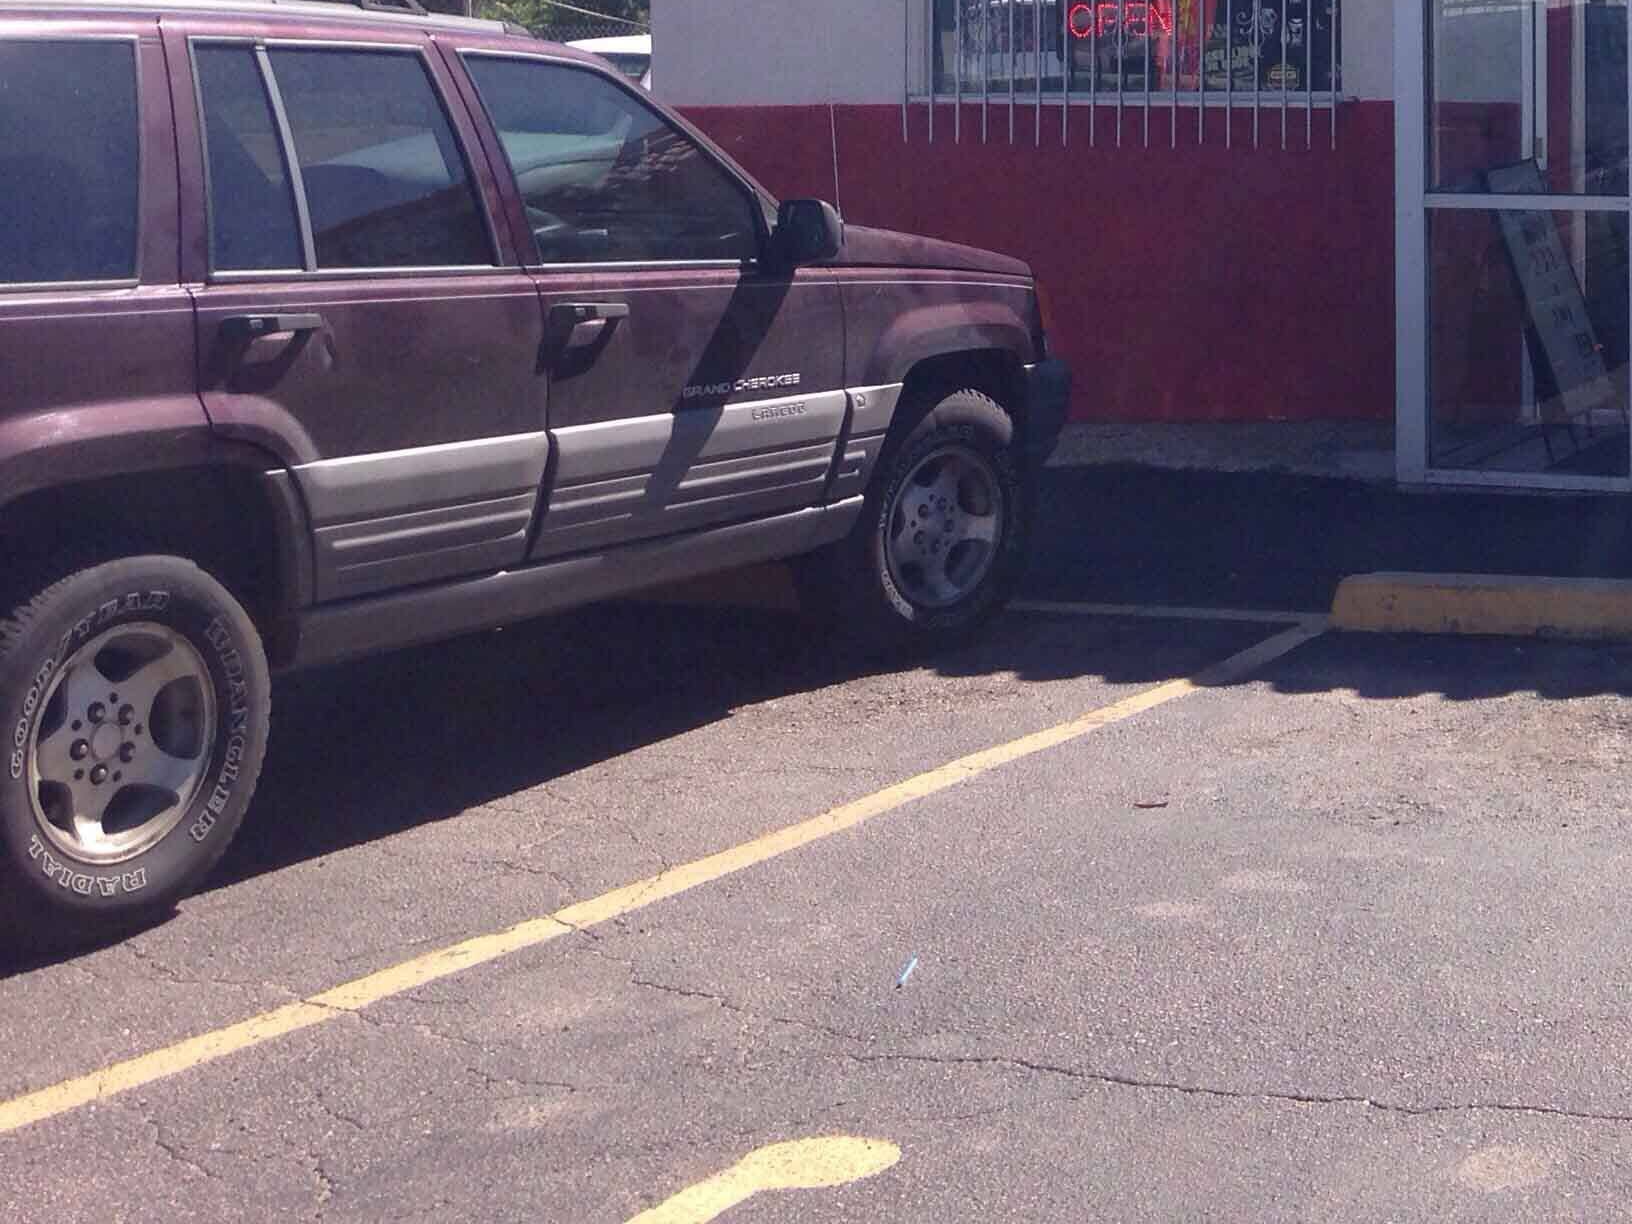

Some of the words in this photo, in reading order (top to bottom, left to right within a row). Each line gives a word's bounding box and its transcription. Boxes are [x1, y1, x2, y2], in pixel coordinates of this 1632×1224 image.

[1069, 0, 1173, 39] OPEN
[683, 382, 731, 398] GRAND
[735, 373, 801, 392] CHEROKEE
[28, 834, 147, 897] RADIAL
